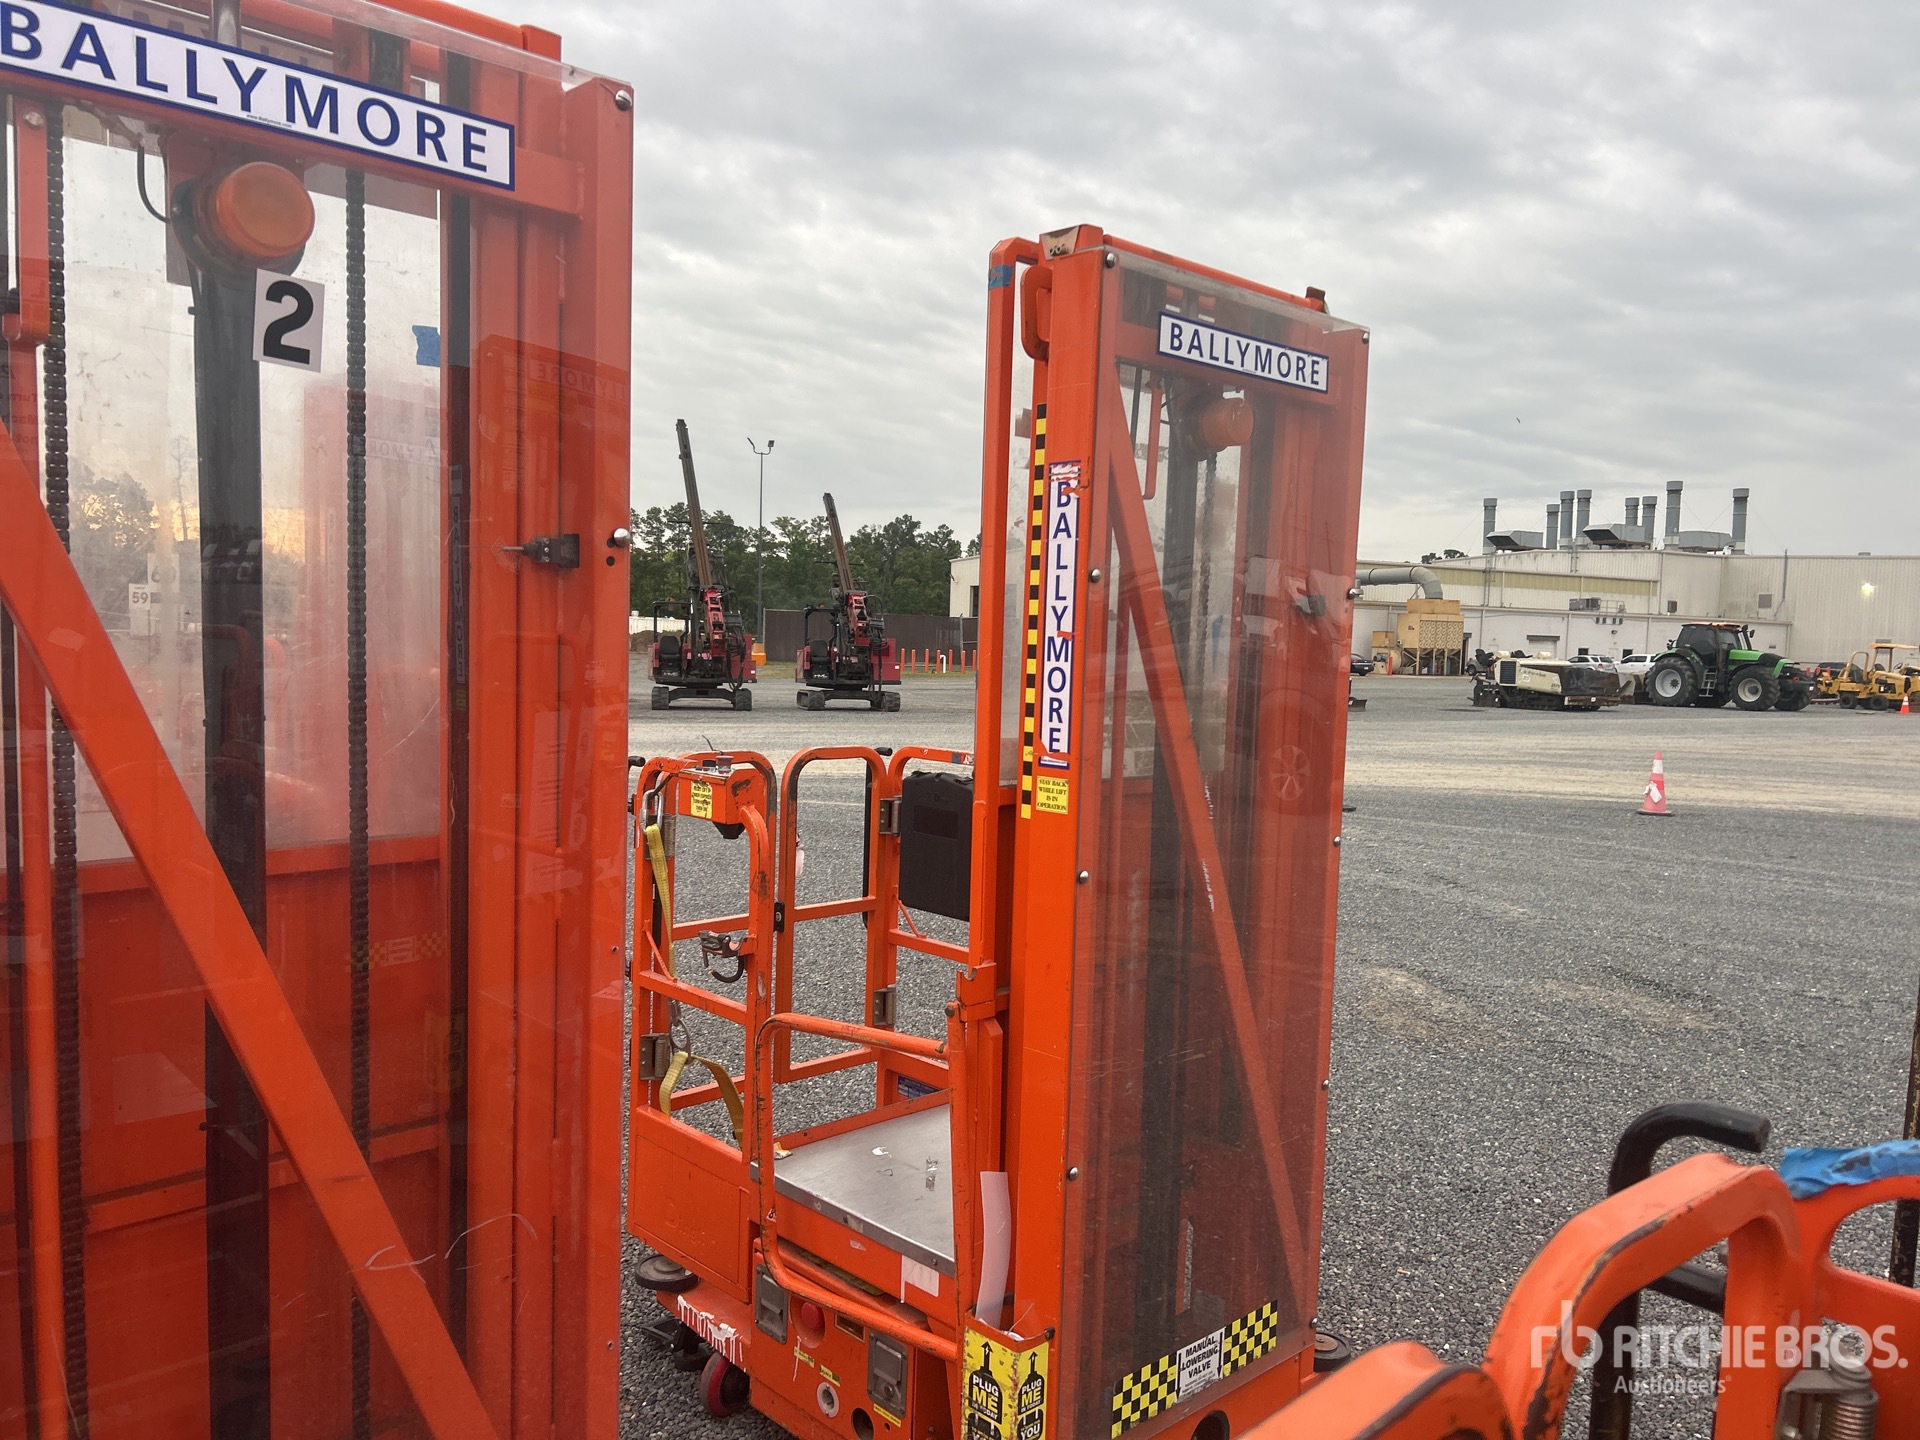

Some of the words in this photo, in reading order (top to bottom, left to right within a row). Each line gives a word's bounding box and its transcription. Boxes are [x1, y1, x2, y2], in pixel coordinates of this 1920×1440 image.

[0, 2, 488, 173] BALLYMORE
[263, 280, 313, 365] 2
[1169, 323, 1320, 387] BALLYMORE
[132, 591, 149, 604] 59
[1046, 480, 1072, 753] BALLYMORE
[1052, 780, 1067, 788] BACK
[1037, 802, 1067, 811] OPERATION
[1186, 1336, 1216, 1358] MANUAL
[1182, 1345, 1219, 1371] LOWERING
[1188, 1360, 1211, 1378] VALVE
[973, 1374, 999, 1396] PLUG
[1022, 1378, 1042, 1394] PLUG
[973, 1386, 998, 1413] ME
[1022, 1387, 1042, 1407] ME
[980, 1403, 998, 1420] TODAY
[1020, 1423, 1041, 1440] YOU
